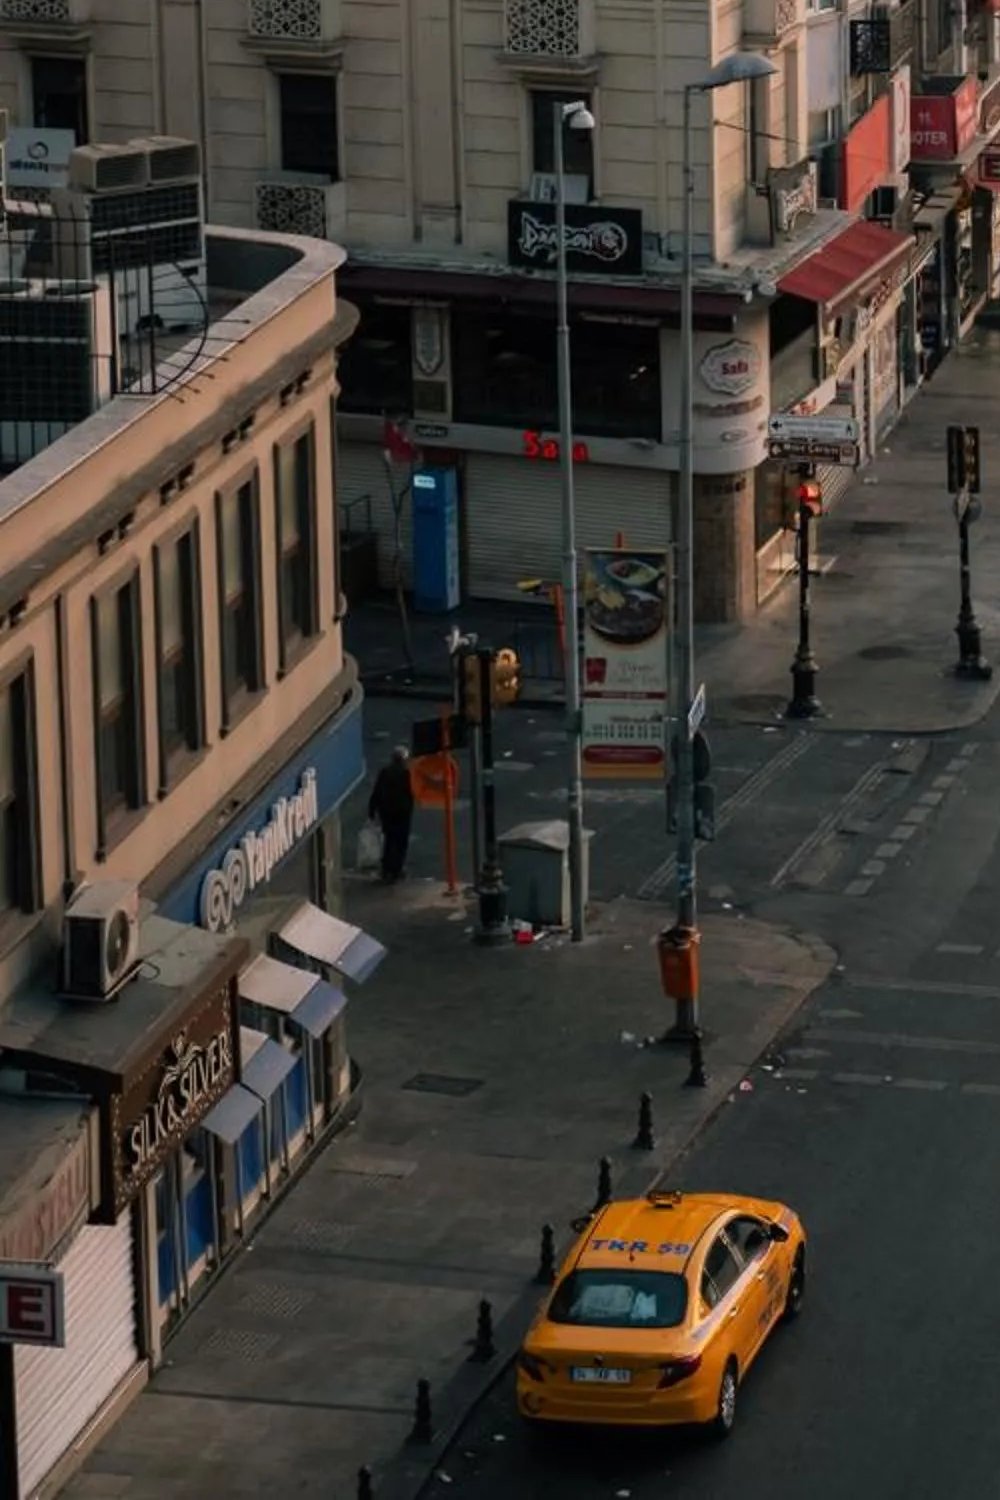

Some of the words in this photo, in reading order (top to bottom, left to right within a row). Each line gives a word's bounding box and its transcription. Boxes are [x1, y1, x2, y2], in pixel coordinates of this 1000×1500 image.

[911, 131, 948, 145] OTER
[522, 429, 591, 462] Saa
[8, 1284, 45, 1332] E
